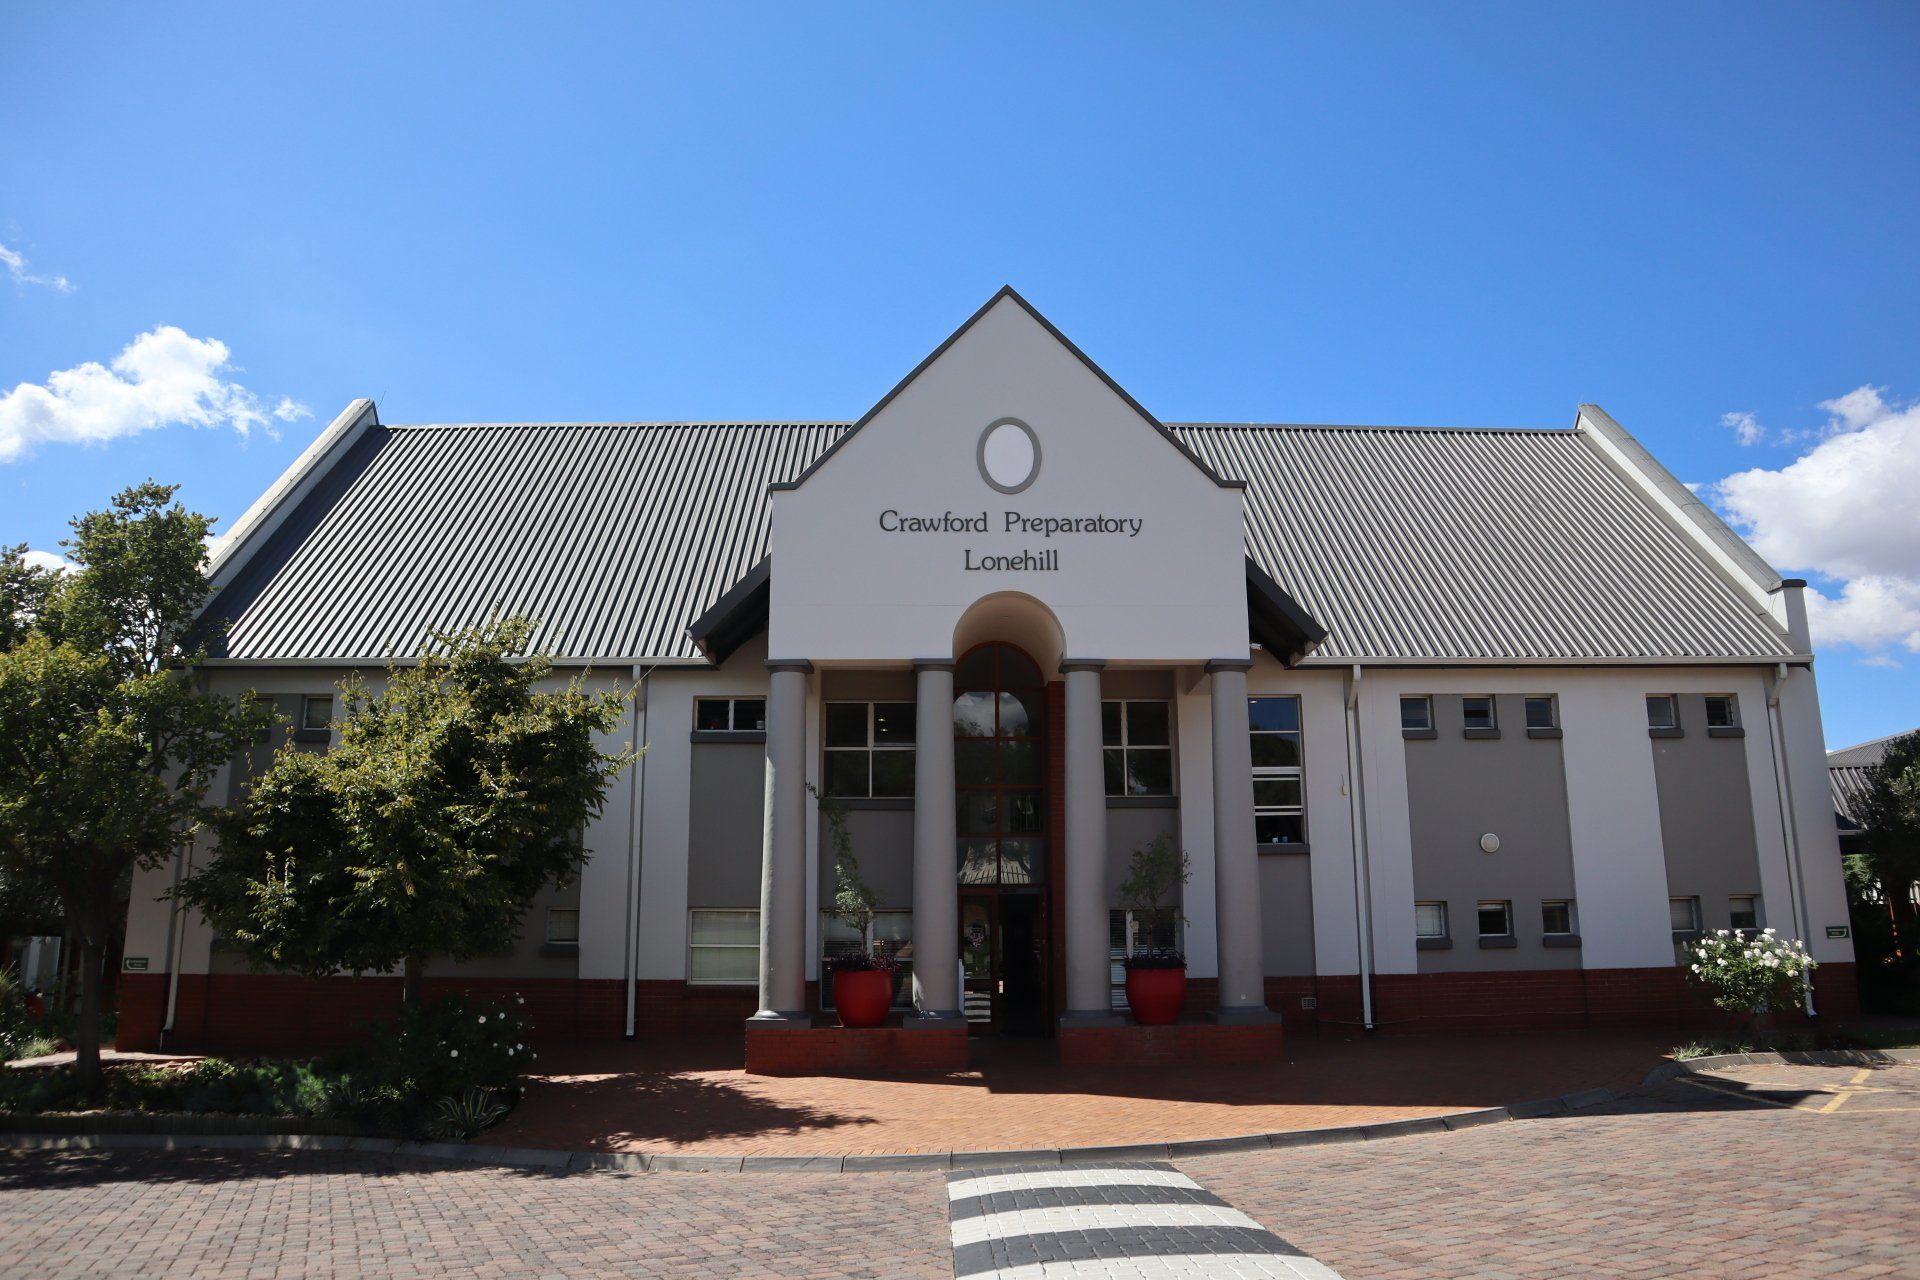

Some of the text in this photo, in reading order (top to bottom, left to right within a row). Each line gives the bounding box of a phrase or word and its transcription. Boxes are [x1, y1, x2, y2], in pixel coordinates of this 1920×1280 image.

[879, 510, 1143, 537] Crawford Preparatory
[964, 549, 1059, 571] Lonehill
